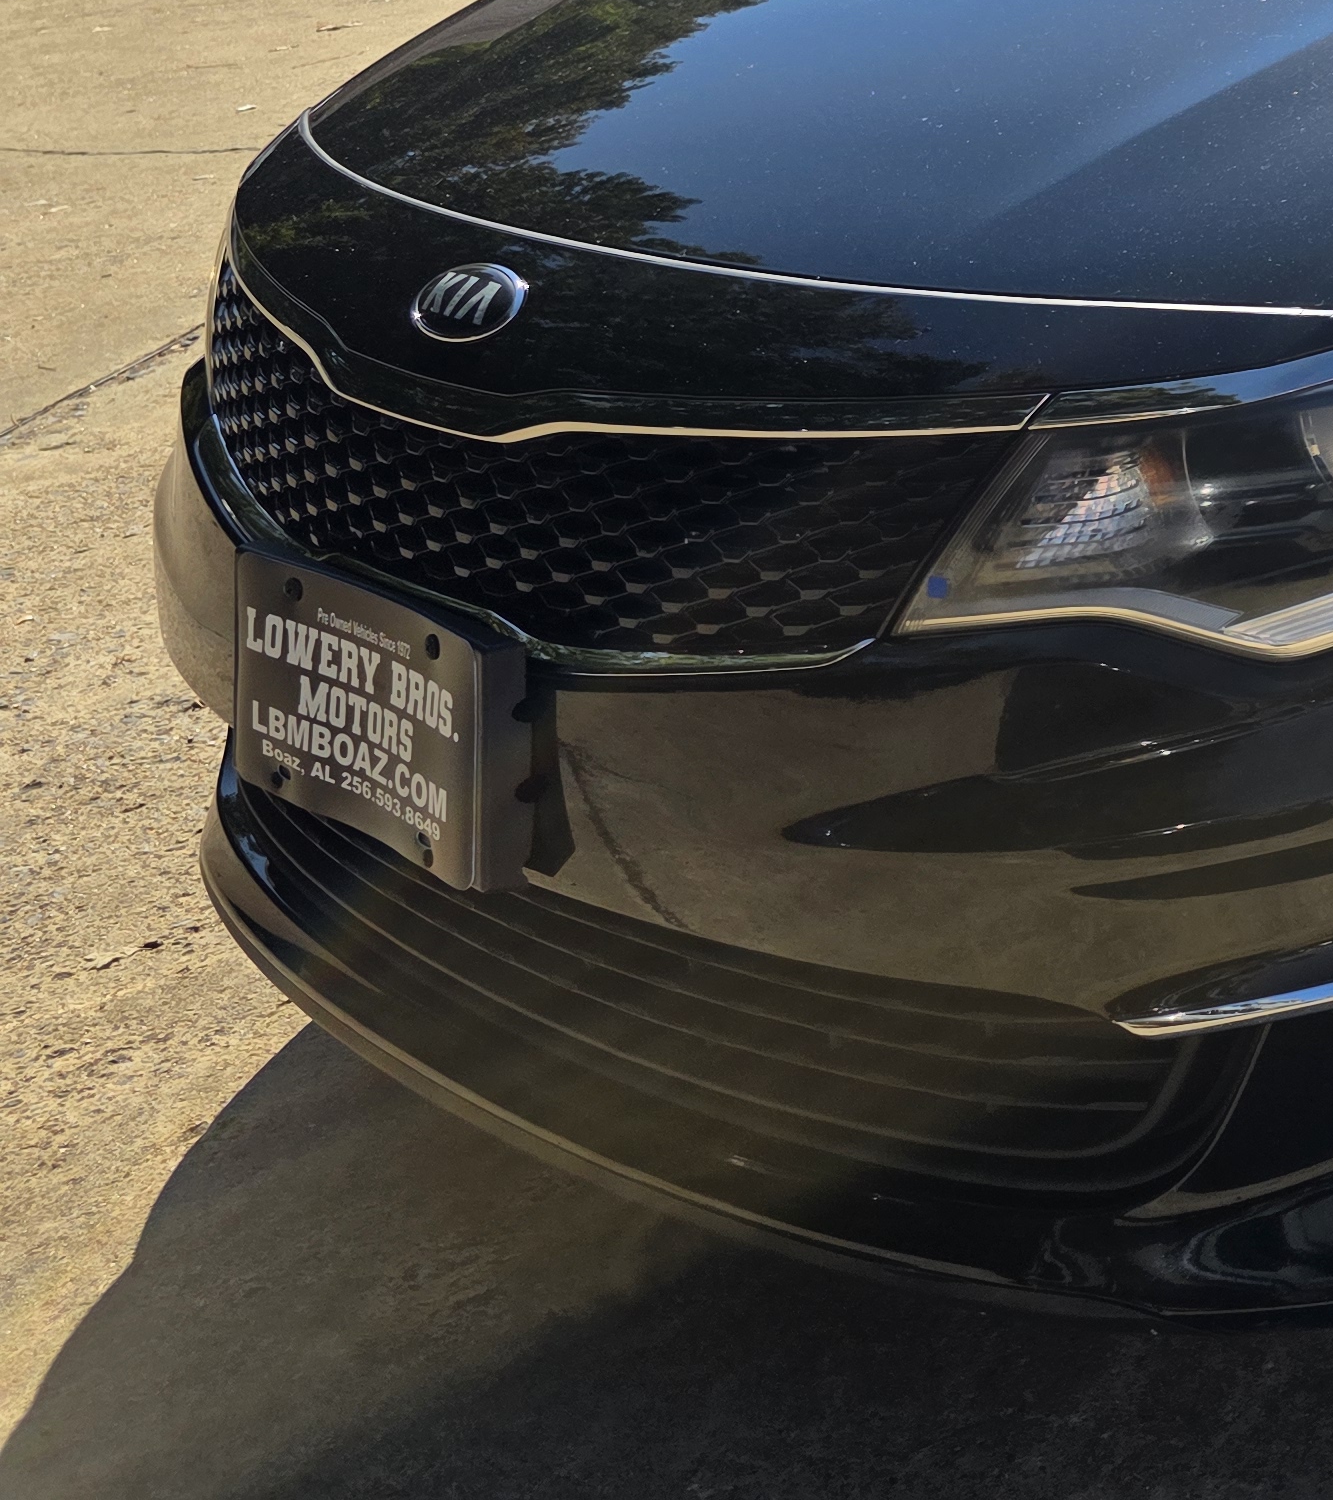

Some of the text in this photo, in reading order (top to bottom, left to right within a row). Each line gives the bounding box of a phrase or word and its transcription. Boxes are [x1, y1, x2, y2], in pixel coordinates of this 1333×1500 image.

[421, 271, 502, 326] KIA
[246, 606, 459, 743] LOWERY BROS.
[317, 607, 329, 625] Pre
[353, 620, 379, 646] Vehicles
[379, 632, 396, 653] Since
[252, 699, 447, 823] LBMBOAZ.COM
[298, 674, 414, 763] MOTORS
[262, 739, 441, 841] Boaz, AL 256.593.8649
